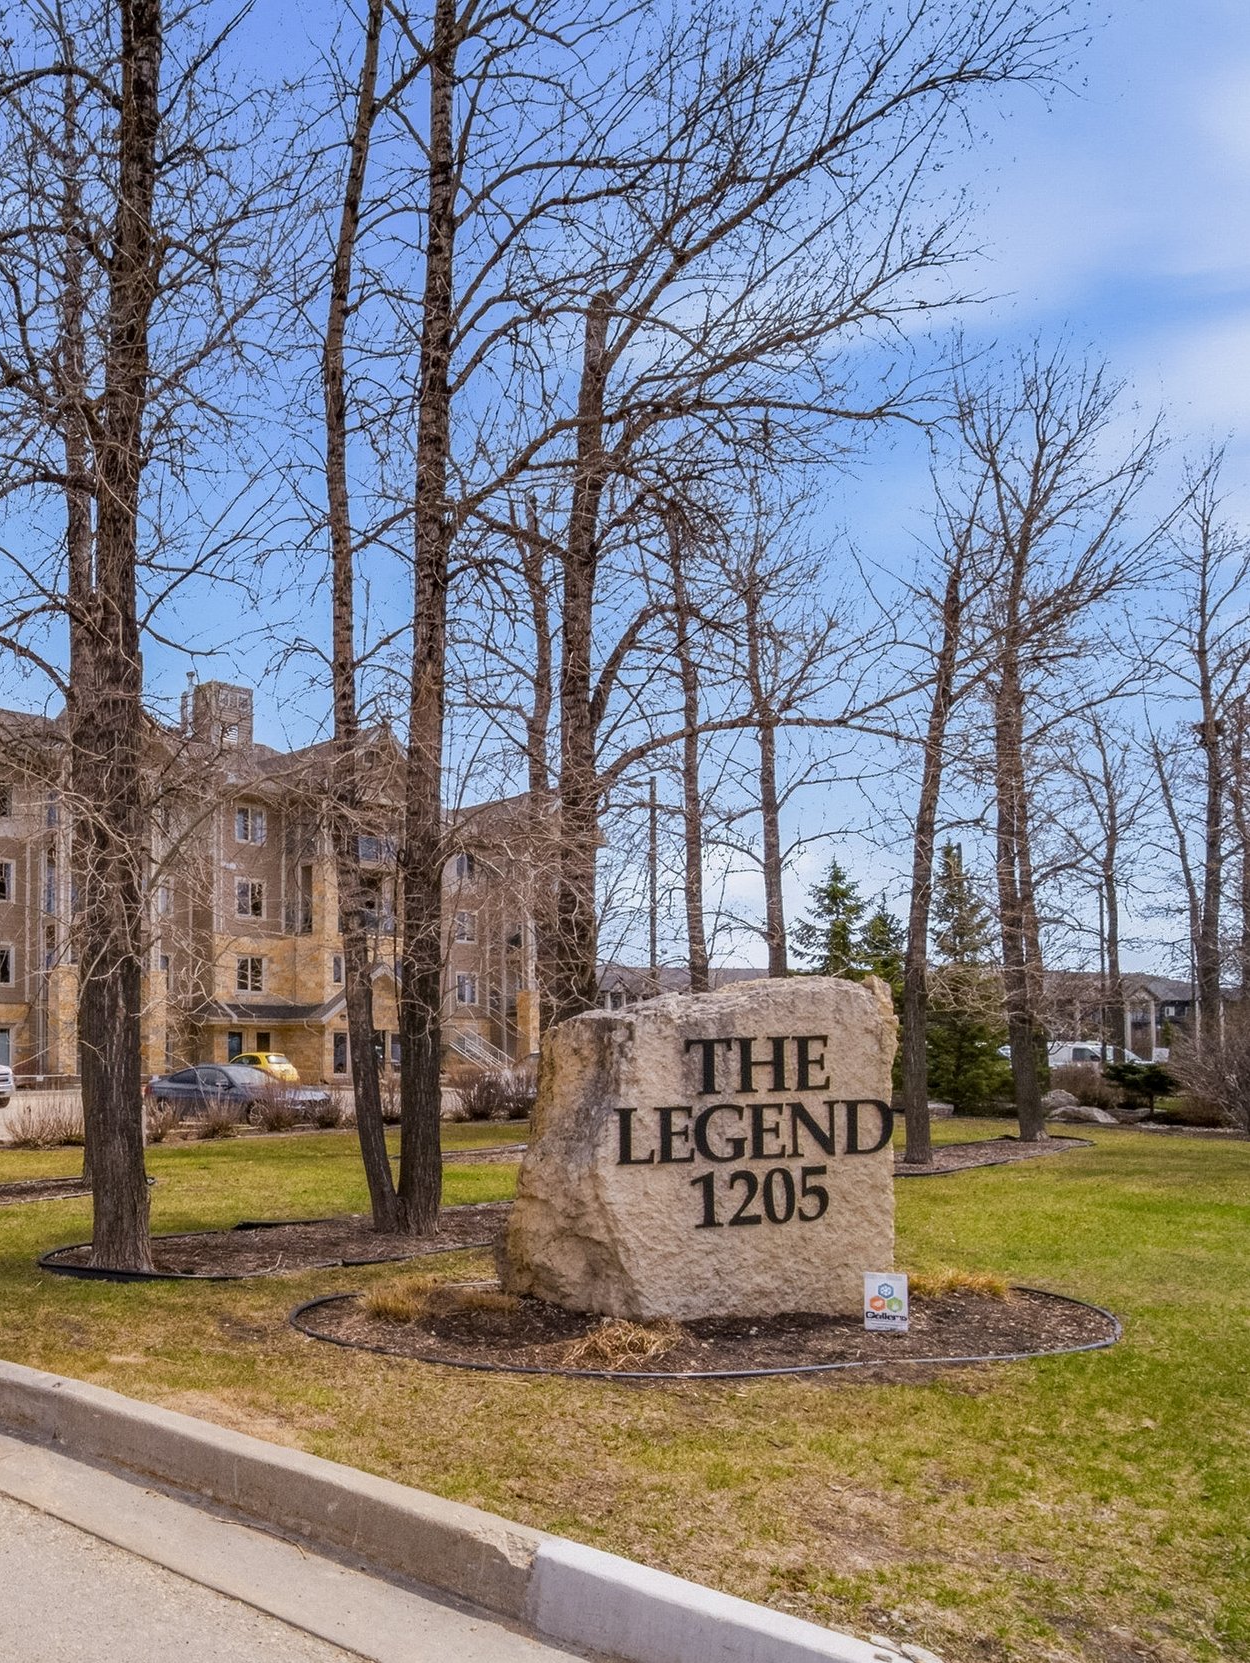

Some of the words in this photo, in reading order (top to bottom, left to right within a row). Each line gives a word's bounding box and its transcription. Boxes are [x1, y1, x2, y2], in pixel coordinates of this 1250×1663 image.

[684, 1034, 831, 1096] THE
[613, 1098, 895, 1166] LEGEND
[690, 1164, 830, 1229] 1205
